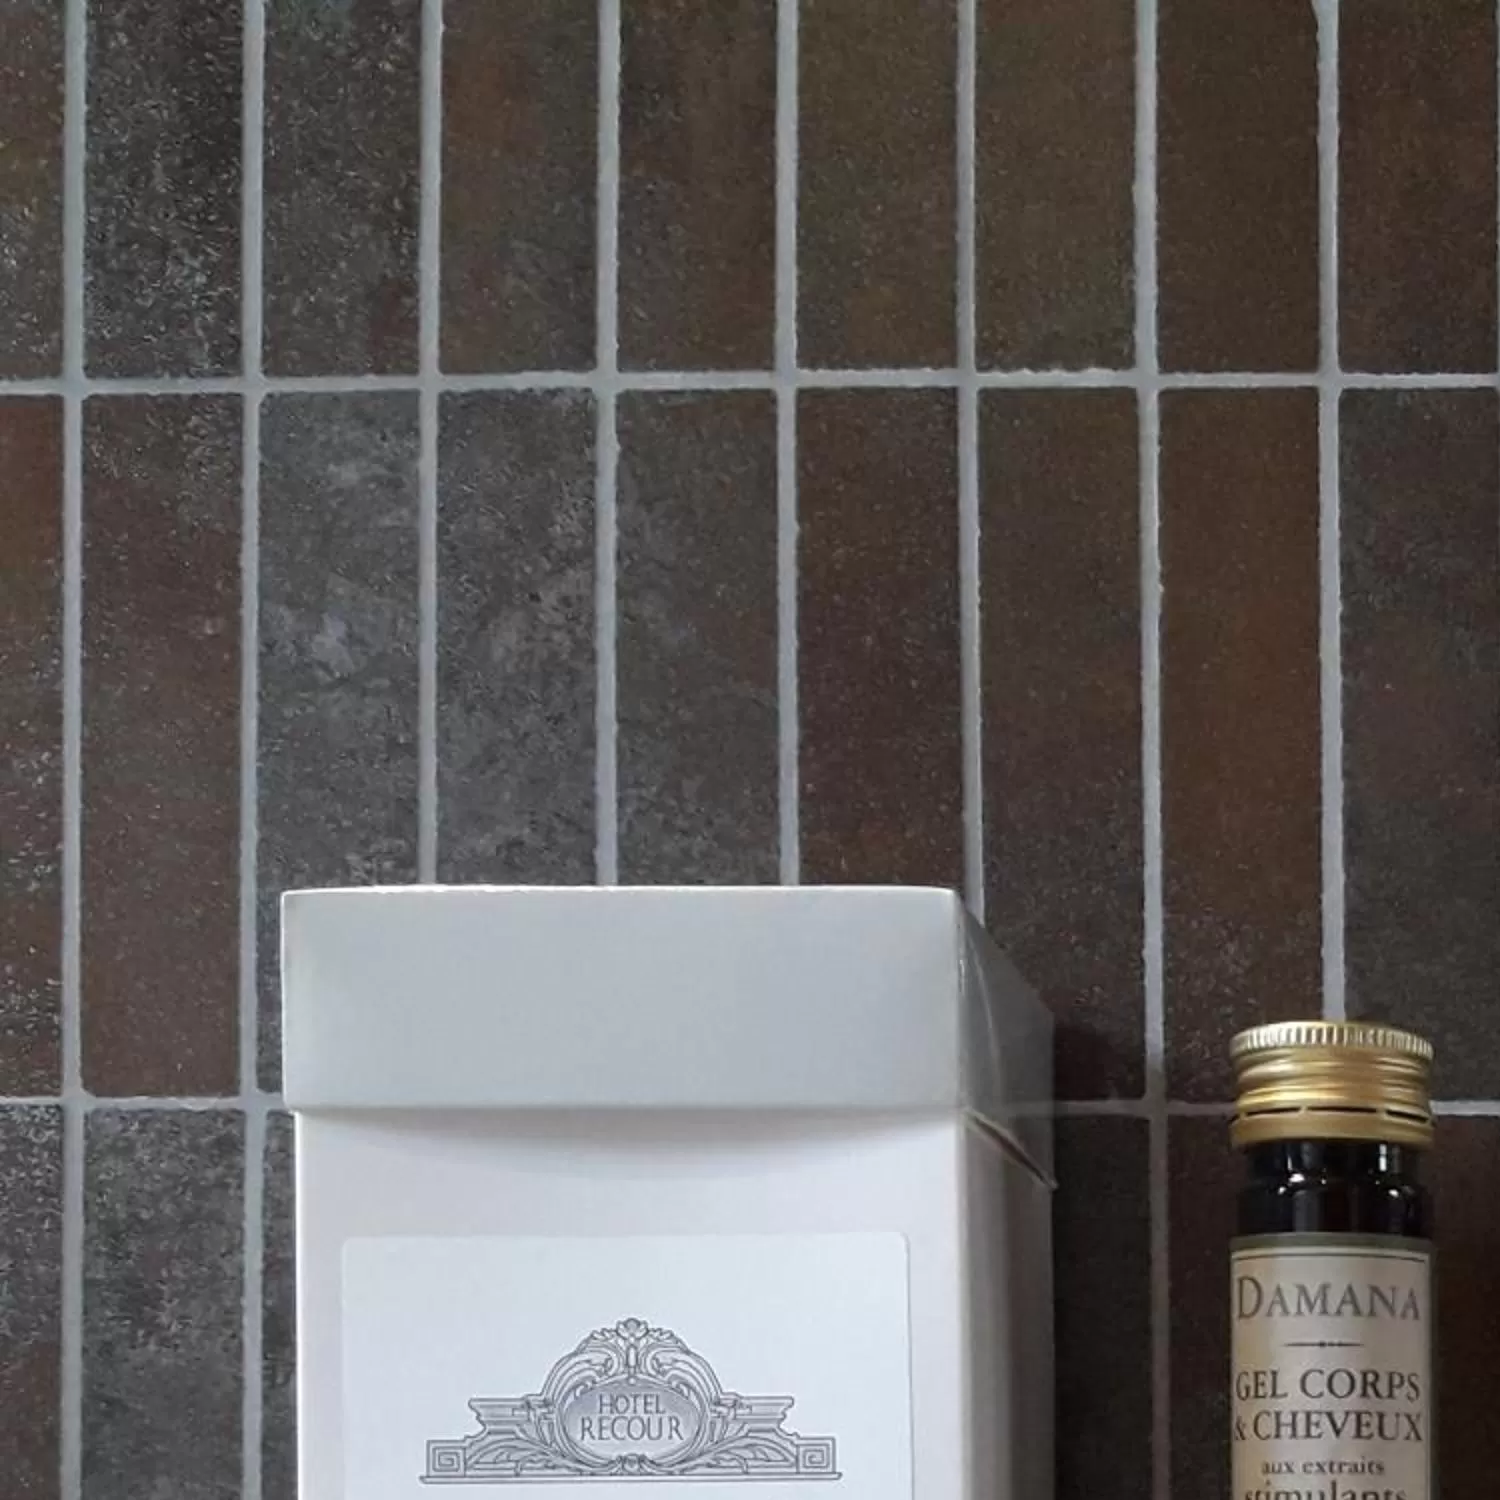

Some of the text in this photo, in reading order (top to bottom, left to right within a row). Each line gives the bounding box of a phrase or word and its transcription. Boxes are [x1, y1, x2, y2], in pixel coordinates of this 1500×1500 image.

[1238, 1276, 1420, 1321] DAMANA
[1236, 1368, 1420, 1403] GEL CORPS
[599, 1393, 665, 1414] HOTEL
[580, 1415, 684, 1441] RECOUR
[1253, 1410, 1423, 1441] CHEVEUX
[1262, 1456, 1384, 1474] aux extraits
